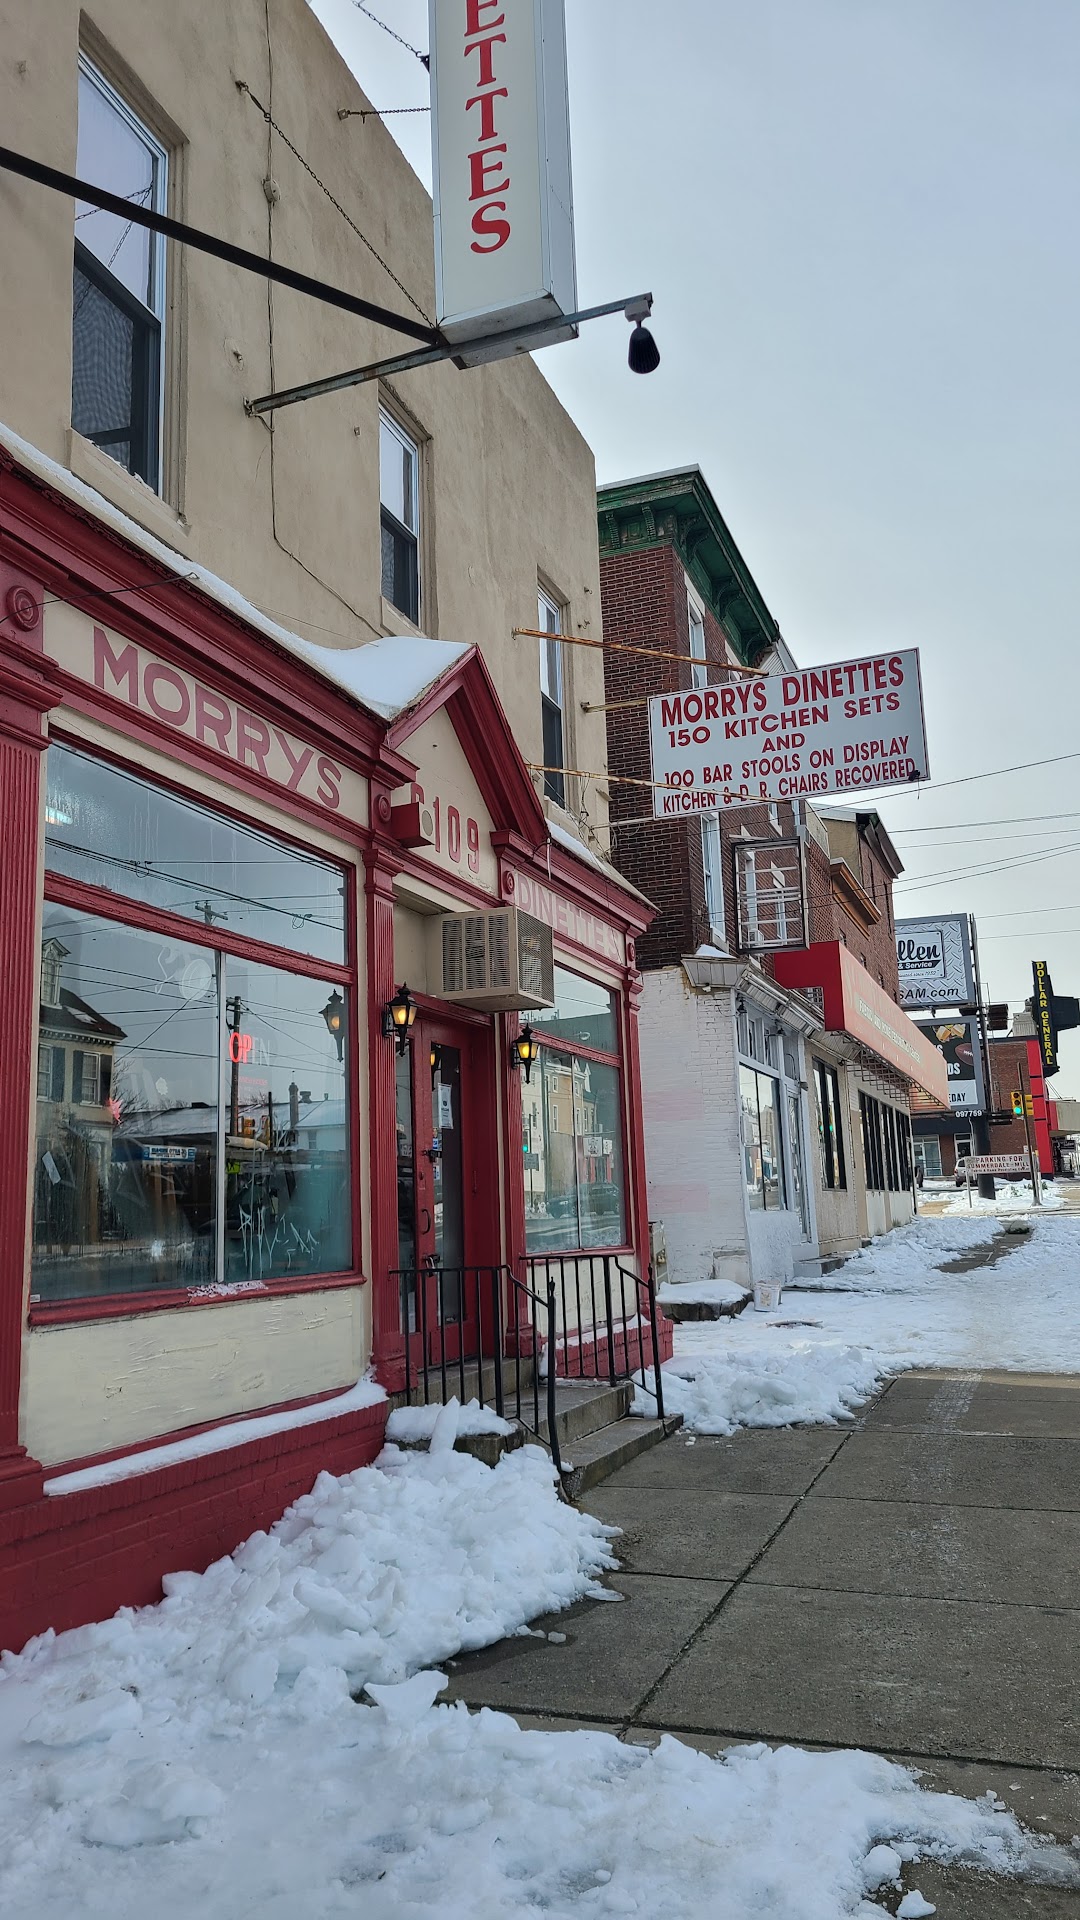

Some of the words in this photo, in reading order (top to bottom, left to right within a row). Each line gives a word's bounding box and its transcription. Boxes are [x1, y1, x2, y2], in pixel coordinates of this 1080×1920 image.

[94, 626, 342, 809] MORRYS
[661, 682, 767, 728] MORRYS
[782, 656, 904, 706] DINETTES
[668, 725, 711, 748] 150
[724, 705, 829, 739] KITCHEN
[843, 692, 901, 719] SETS
[664, 769, 694, 789] 100
[703, 763, 733, 784] BAR
[742, 753, 800, 779] STOOLS
[810, 748, 834, 769] ON
[843, 735, 909, 764] DISPLAY
[761, 732, 805, 753] AND
[663, 790, 717, 813] KITCHEN
[723, 786, 732, 804] &
[779, 771, 828, 796] CHAIRS
[835, 758, 916, 787] RECOVERED
[518, 873, 619, 961] DINETTES
[1036, 962, 1047, 1007] DOLLAR
[1042, 1011, 1053, 1065] GENERAL
[229, 1032, 270, 1066] OPEN
